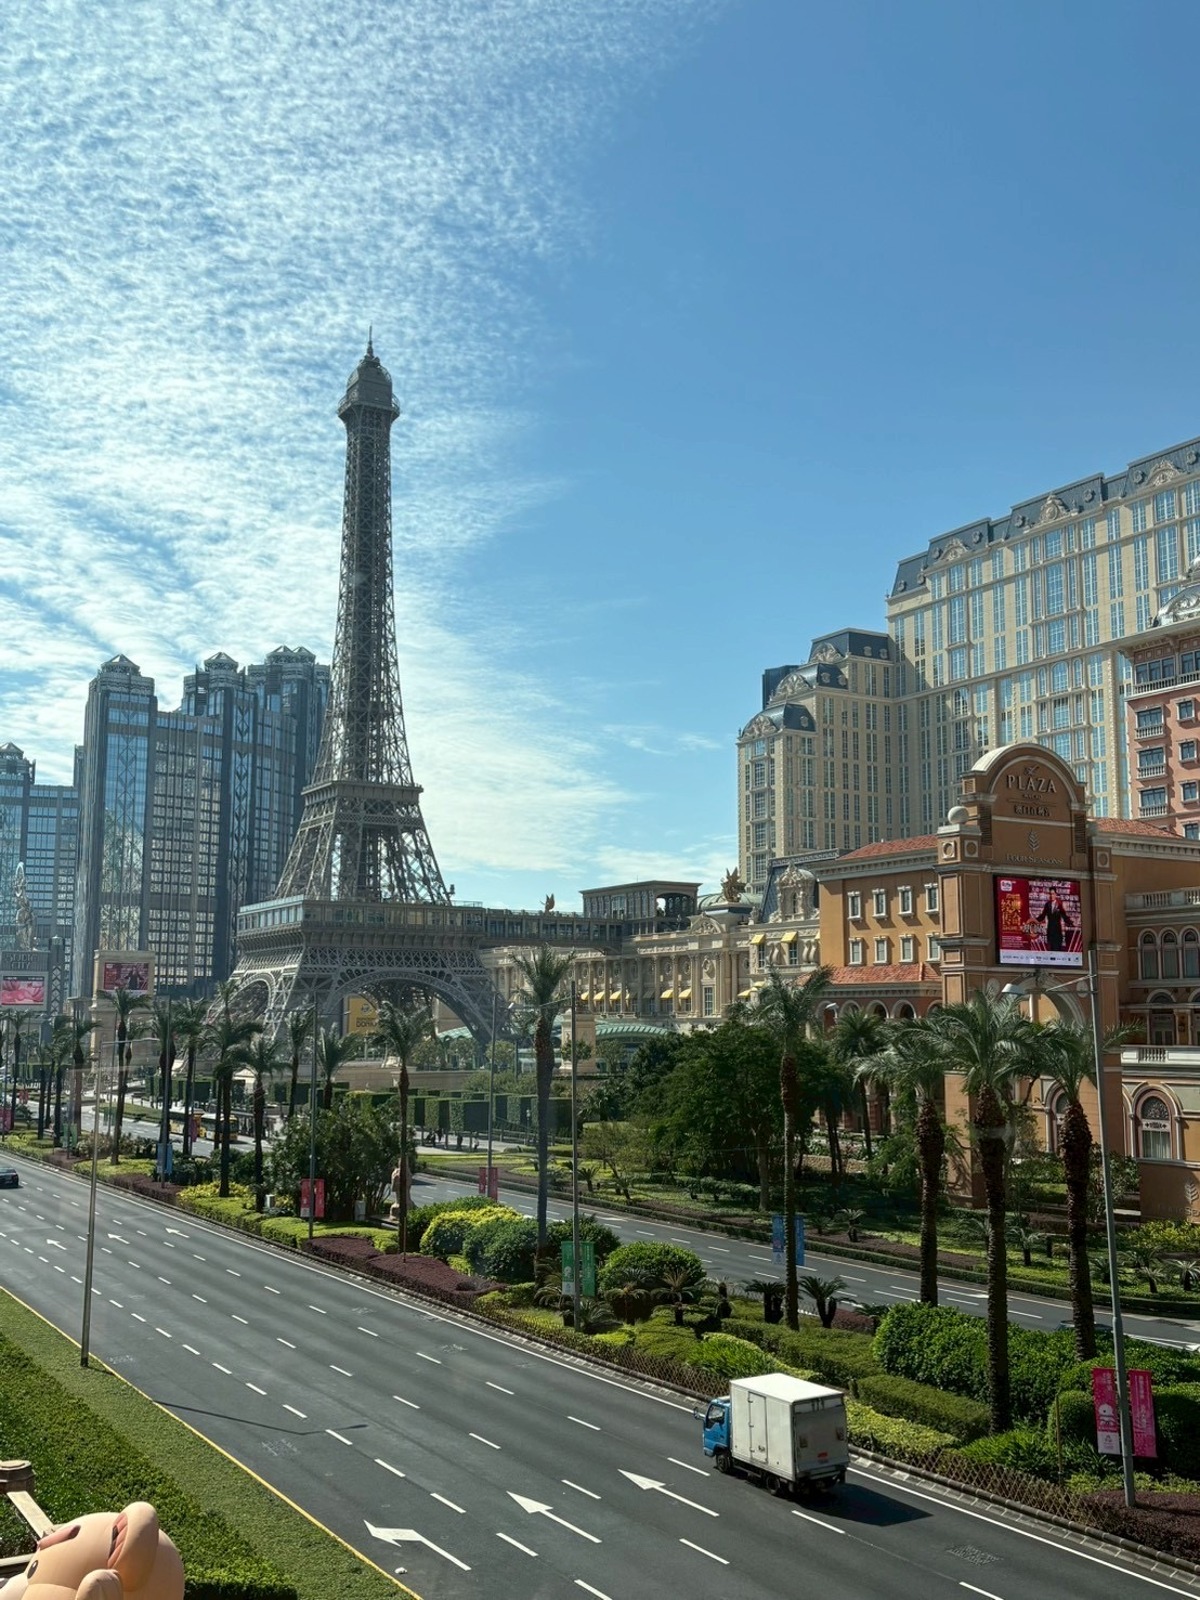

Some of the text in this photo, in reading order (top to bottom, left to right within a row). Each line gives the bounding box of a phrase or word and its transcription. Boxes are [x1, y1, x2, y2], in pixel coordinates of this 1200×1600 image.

[1006, 774, 1057, 793] PLAZA
[1005, 853, 1063, 865] FOUR SEASONS
